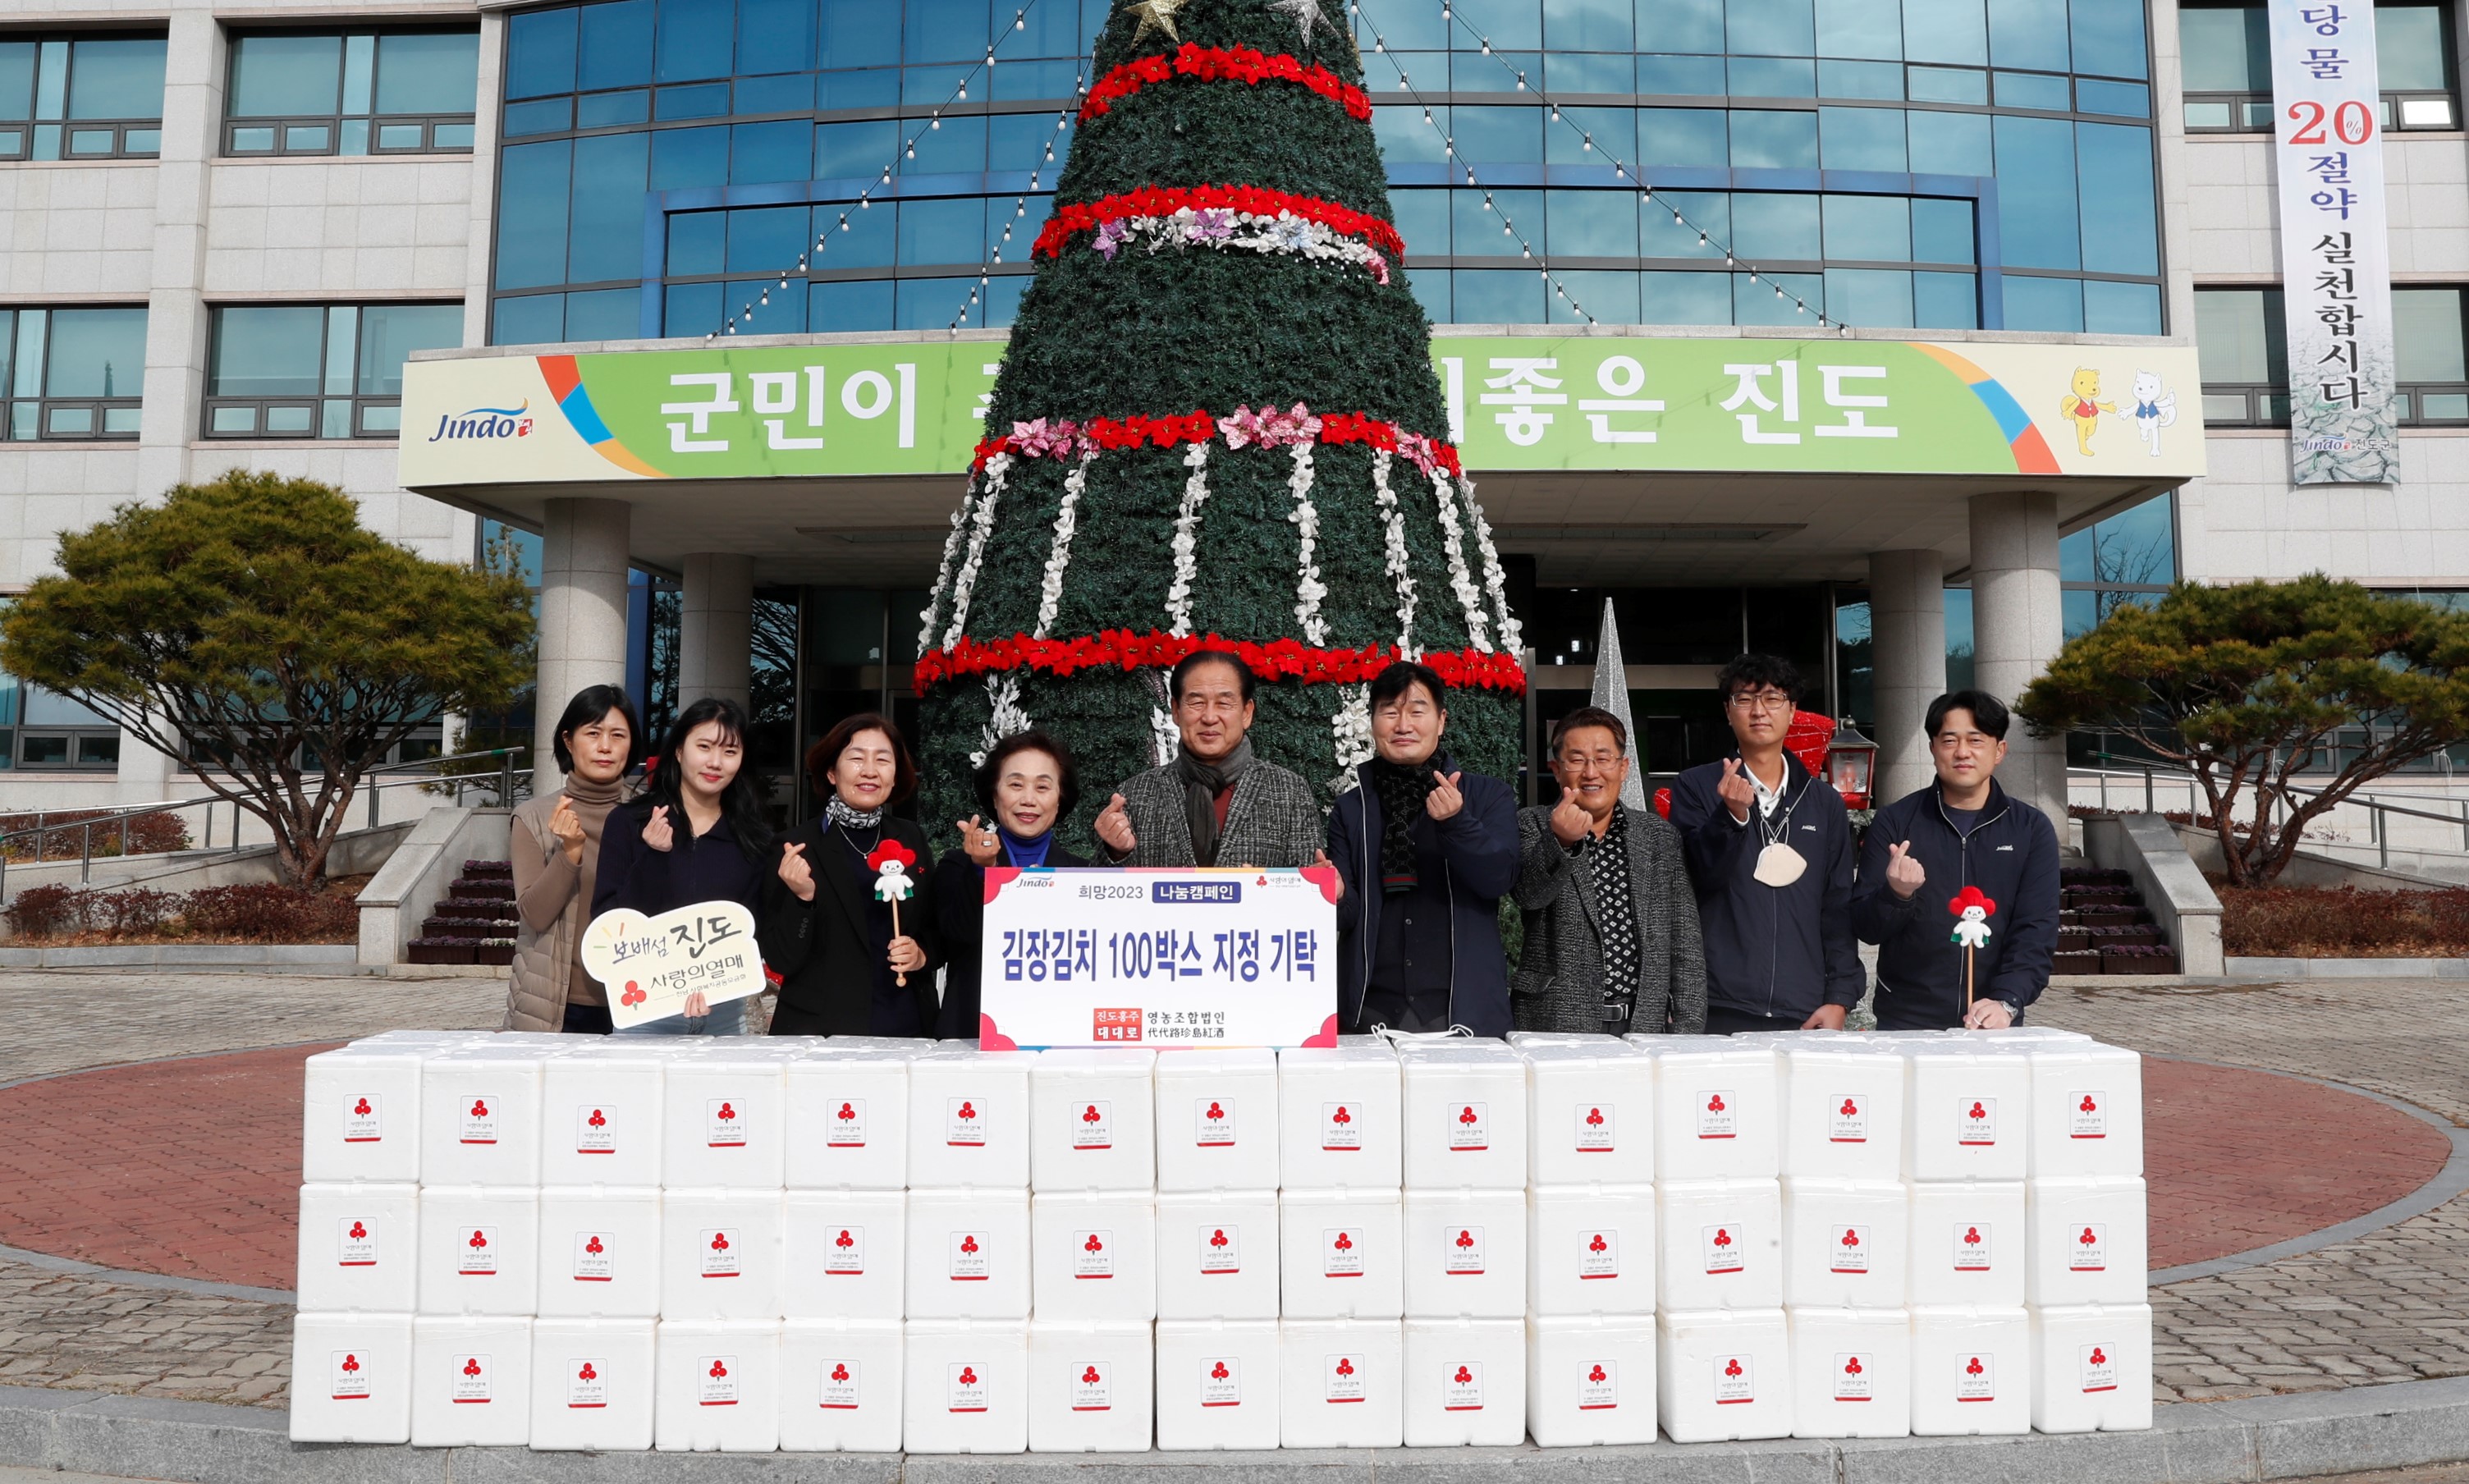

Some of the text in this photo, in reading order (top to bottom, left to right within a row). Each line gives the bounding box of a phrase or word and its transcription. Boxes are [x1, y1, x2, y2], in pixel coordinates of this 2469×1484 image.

[2299, 4, 2348, 36] 당
[2300, 48, 2349, 80] 물
[2306, 151, 2358, 221] 절약
[2311, 231, 2370, 411] 실천합시다
[660, 362, 917, 454] 군민이
[1718, 359, 1899, 445] 진도
[428, 414, 516, 443] Jindo
[2299, 439, 2343, 453] Jindo
[2355, 438, 2390, 451] 진도군
[1016, 877, 1048, 888] Jindo
[1078, 884, 1234, 900] 희망2023 나눔캠페인
[612, 916, 743, 964] 보배섬 진도
[1001, 928, 1318, 982] 김장김치 100박스 지정 기탁
[1096, 1010, 1140, 1023] 진도홍주
[1147, 1011, 1225, 1024] 영농조합법인
[1097, 1026, 1139, 1040] 대대로
